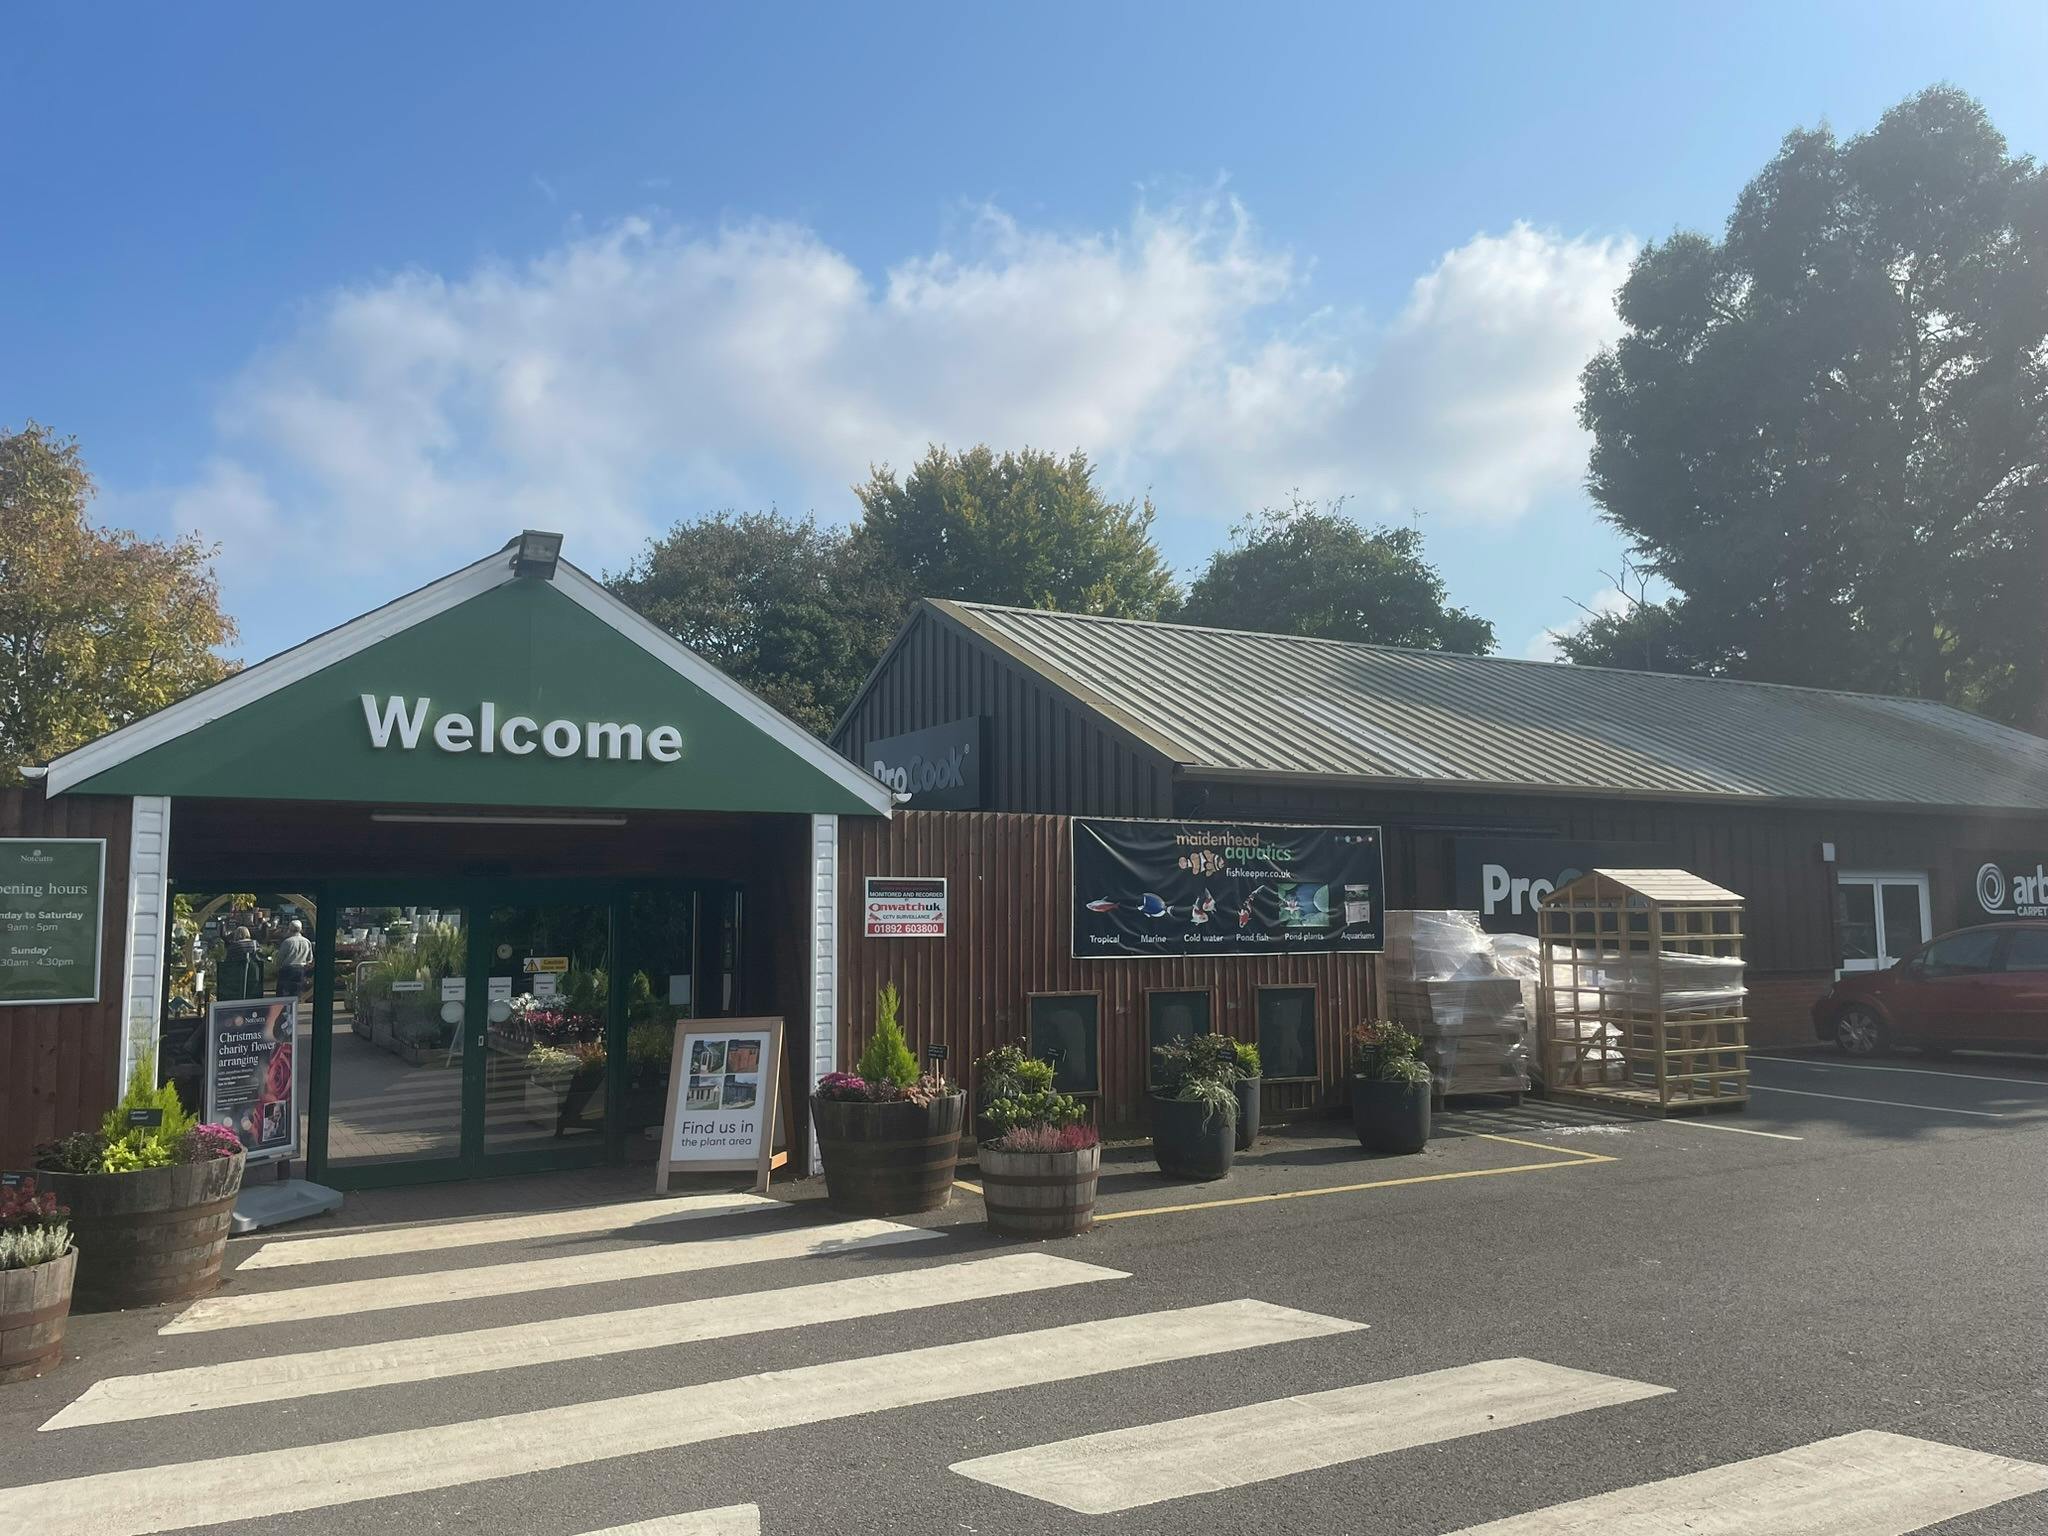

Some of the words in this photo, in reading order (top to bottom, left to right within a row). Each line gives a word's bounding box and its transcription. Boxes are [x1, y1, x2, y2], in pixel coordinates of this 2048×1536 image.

[361, 693, 683, 762] Welcome
[1176, 831, 1260, 847] maidenhead
[1224, 843, 1292, 865] aquatics
[1226, 868, 1291, 880] fishkeeper.co.uk
[48, 882, 88, 895] hours
[25, 911, 36, 919] to
[38, 911, 84, 921] Saturday
[7, 923, 29, 932] 9am
[36, 922, 59, 933] 5pm
[874, 924, 902, 933] 01892
[905, 924, 939, 933] 603800
[1090, 934, 1120, 945] Tropical
[1140, 934, 1167, 943] Marine
[1184, 933, 1201, 943] Cold
[1203, 934, 1224, 943] water
[1235, 933, 1255, 942] Pond
[1256, 933, 1270, 942] fish
[1284, 932, 1301, 941] Pond
[1303, 931, 1324, 942] plants
[1340, 931, 1376, 940] Aquariums
[36, 957, 74, 968] 4.30pm
[219, 1031, 262, 1043] Christmas
[218, 1043, 249, 1056] charity
[251, 1041, 276, 1052] flower
[218, 1055, 259, 1068] arranging
[682, 1121, 715, 1135] Find
[719, 1123, 736, 1134] us
[741, 1120, 754, 1133] in
[681, 1138, 698, 1147] the
[699, 1137, 726, 1148] plant
[728, 1138, 752, 1146] area
